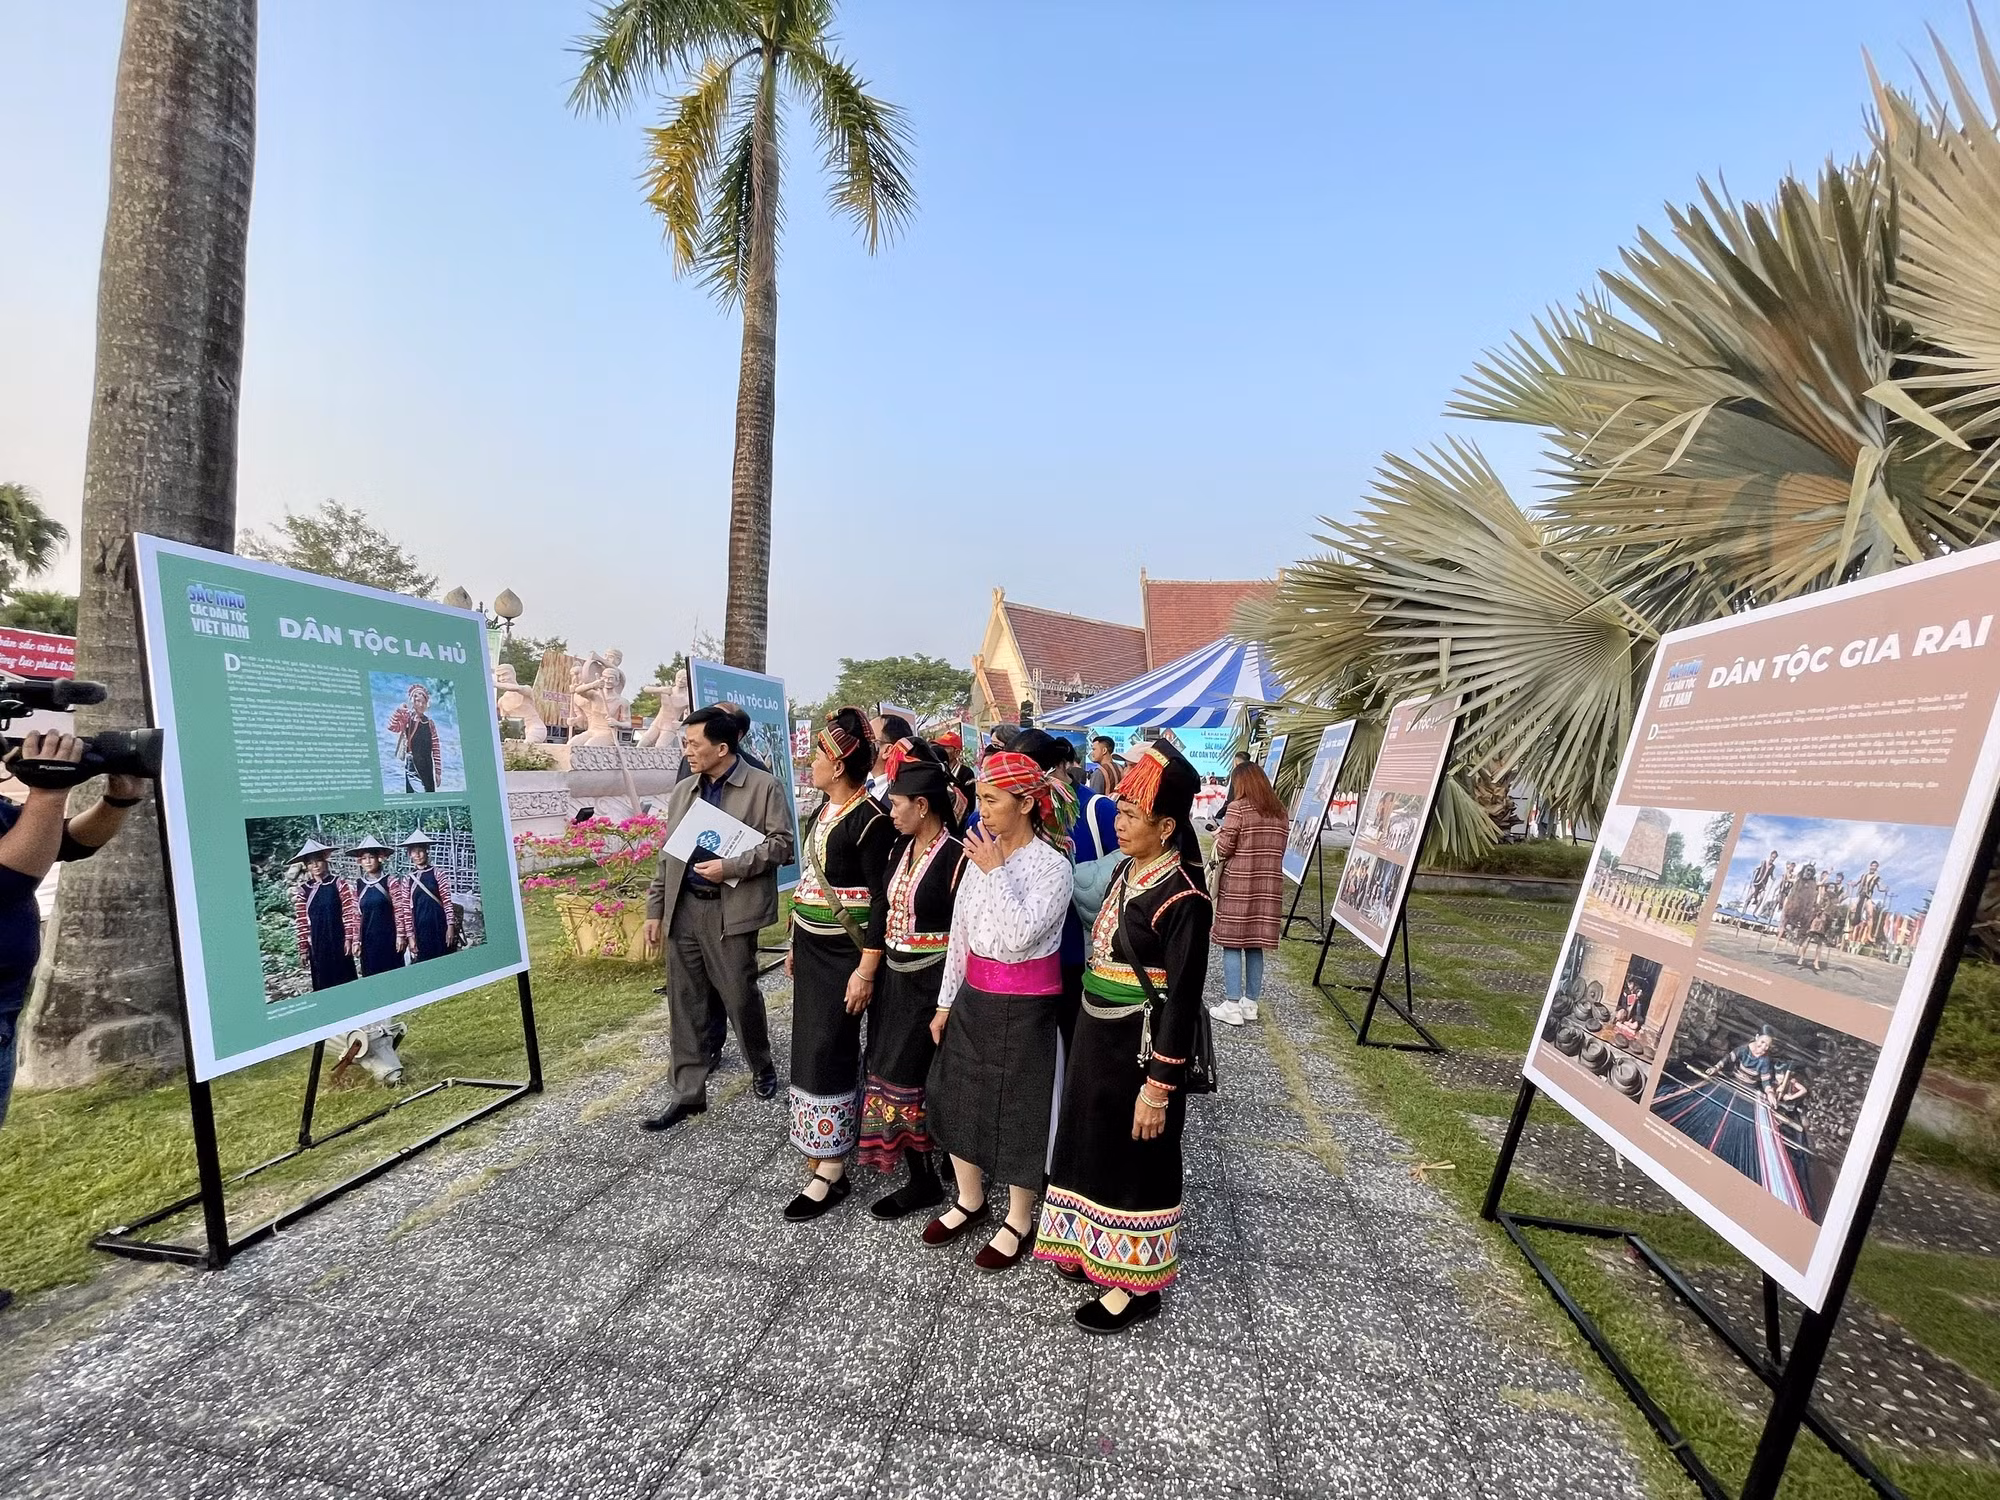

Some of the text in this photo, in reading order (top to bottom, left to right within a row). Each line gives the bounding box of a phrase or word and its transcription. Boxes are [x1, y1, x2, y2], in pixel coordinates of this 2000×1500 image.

[191, 617, 250, 640] VIỆT NAM
[279, 616, 467, 665] DÂN TỘC LA HỦ
[1707, 614, 1994, 689] DÂN TỘC GIA RAI
[726, 690, 746, 706] DÂN
[746, 693, 763, 710] TỘC
[763, 697, 779, 711] LÀO
